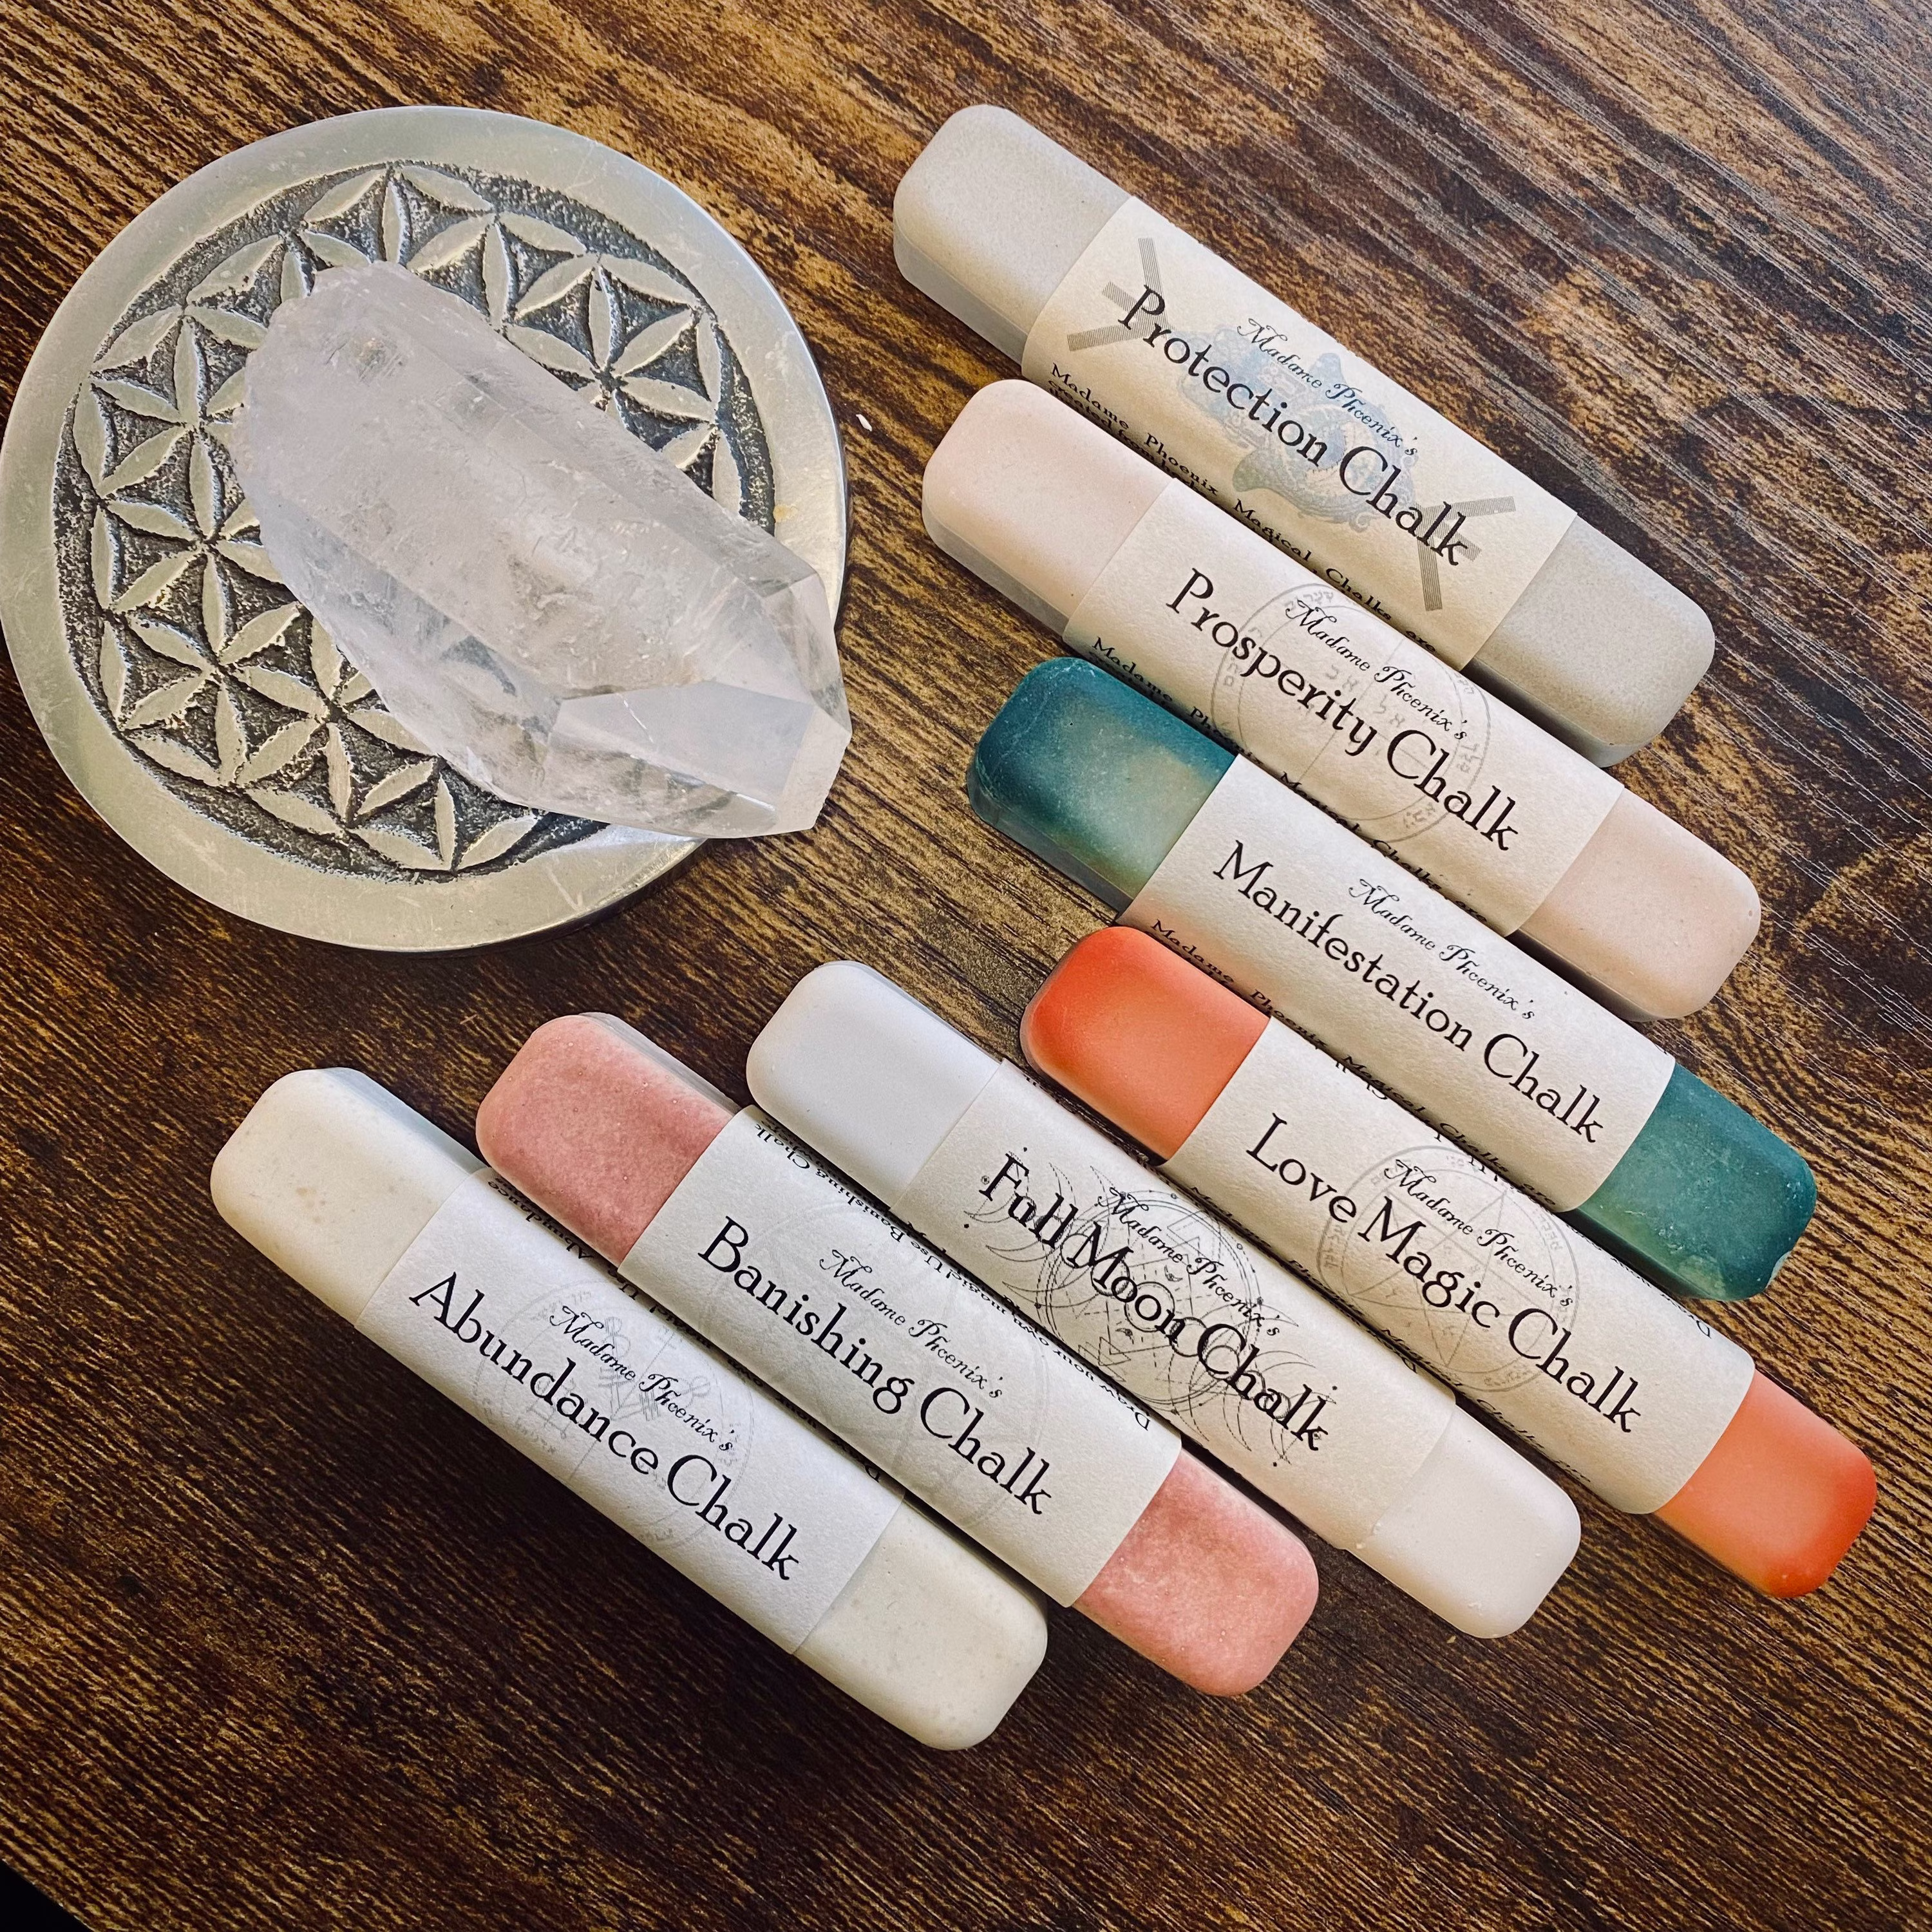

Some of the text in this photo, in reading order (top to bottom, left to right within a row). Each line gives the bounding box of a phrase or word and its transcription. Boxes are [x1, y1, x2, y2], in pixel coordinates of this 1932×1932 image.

[1238, 319, 1321, 386] Madame
[1118, 285, 1468, 565] Protection Chalk
[1050, 362, 1436, 654] Madame Phoenix Magical Chalks are
[1285, 600, 1370, 670] Madame
[1166, 568, 1377, 756] Prosperity
[1388, 730, 1518, 850] Chalk
[1092, 636, 1173, 703] Madame
[1372, 839, 1441, 891] Chalks
[1350, 879, 1435, 949] Madame
[1213, 840, 1472, 1051] Manifestation
[1484, 1034, 1603, 1142] Chalk
[1150, 918, 1235, 984] Madame
[1250, 989, 1328, 1048] Phoenix
[1343, 1055, 1425, 1113] Magical
[1439, 1122, 1509, 1174] Chalks
[1522, 1182, 1556, 1206] are
[753, 1122, 810, 1170] Chalk
[486, 1179, 594, 1260] Abundance
[814, 1168, 905, 1242] Banishing
[1095, 1187, 1184, 1267] Madame
[1384, 1159, 1473, 1235] Madame
[820, 1249, 905, 1325] Madame
[909, 1239, 943, 1273] Use
[945, 1269, 1007, 1314] magic!
[1246, 1113, 1640, 1432] Love Magic Chalk
[978, 1153, 1078, 1249] Full
[1066, 1223, 1189, 1344] Moon
[1196, 1327, 1327, 1450] Chalk
[1012, 1316, 1049, 1346] own
[550, 1306, 636, 1380] Madame
[698, 1216, 914, 1414] Banishing
[921, 1388, 1051, 1514] Chalk
[1051, 1348, 1095, 1381] your
[409, 1272, 799, 1580] Abundance Chalk
[1098, 1383, 1151, 1430] Draw
